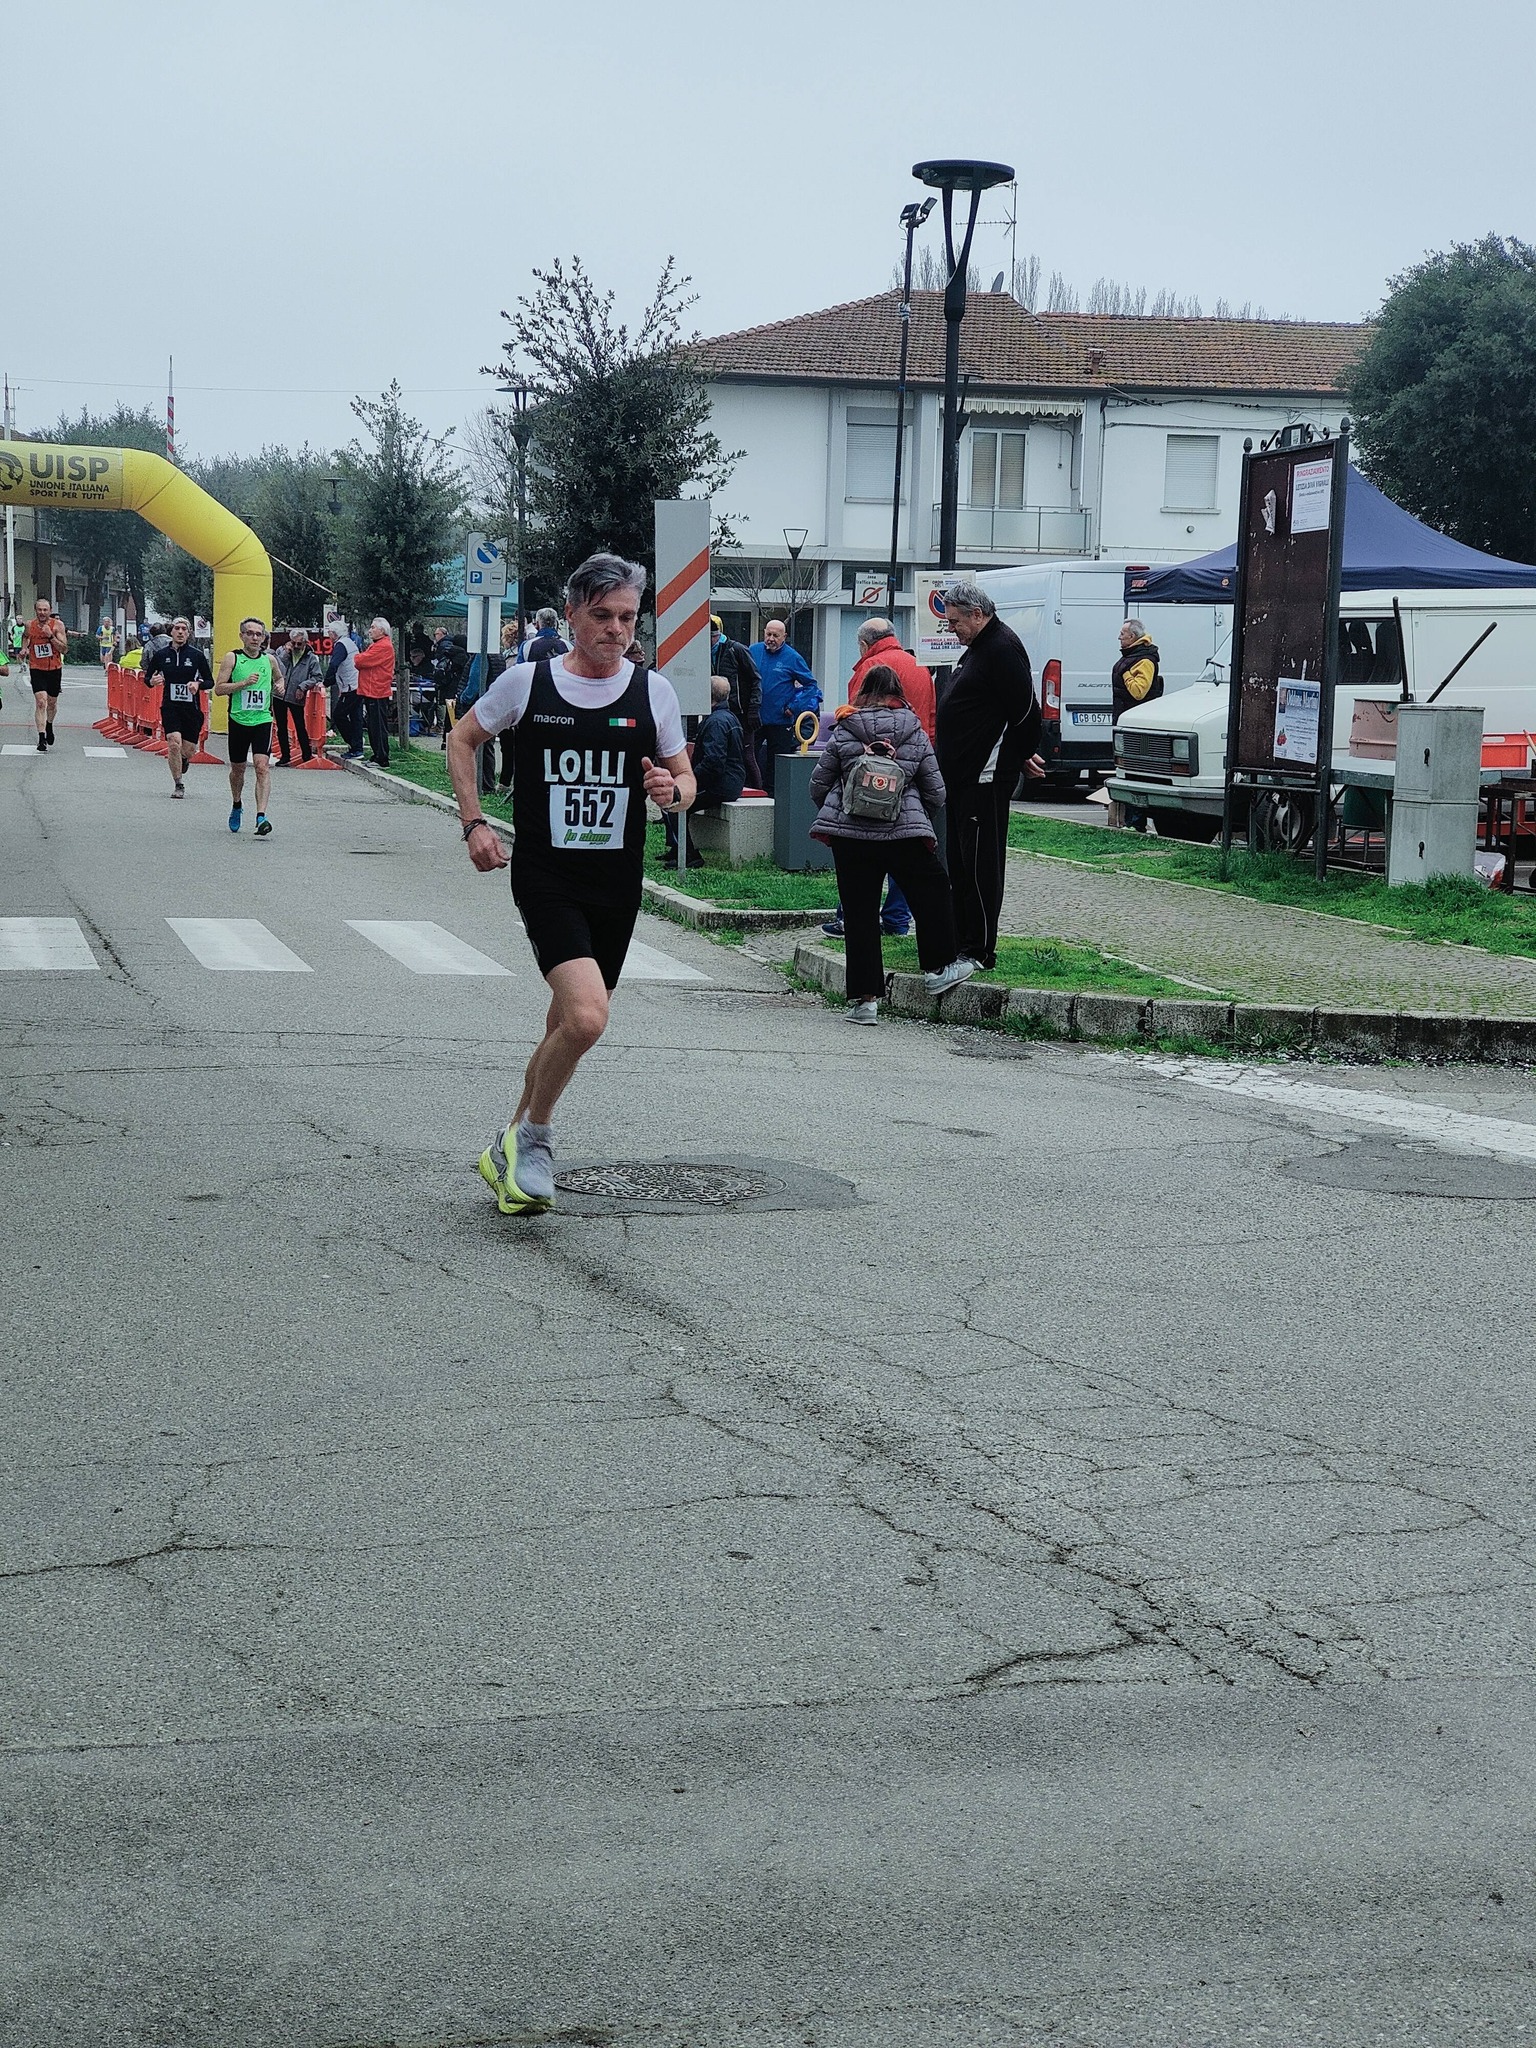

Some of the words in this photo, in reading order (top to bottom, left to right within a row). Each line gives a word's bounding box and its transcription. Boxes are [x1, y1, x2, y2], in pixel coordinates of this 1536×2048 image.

[30, 453, 109, 481] UISP
[30, 480, 65, 490] UNIONE
[70, 483, 110, 493] ITALIANA
[30, 489, 58, 497] SPORT
[62, 491, 78, 499] PER
[472, 572, 480, 583] P
[175, 684, 189, 696] 521
[247, 690, 264, 704] 754
[533, 714, 575, 726] macron
[543, 748, 626, 784] LOLLI
[564, 787, 616, 828] 552
